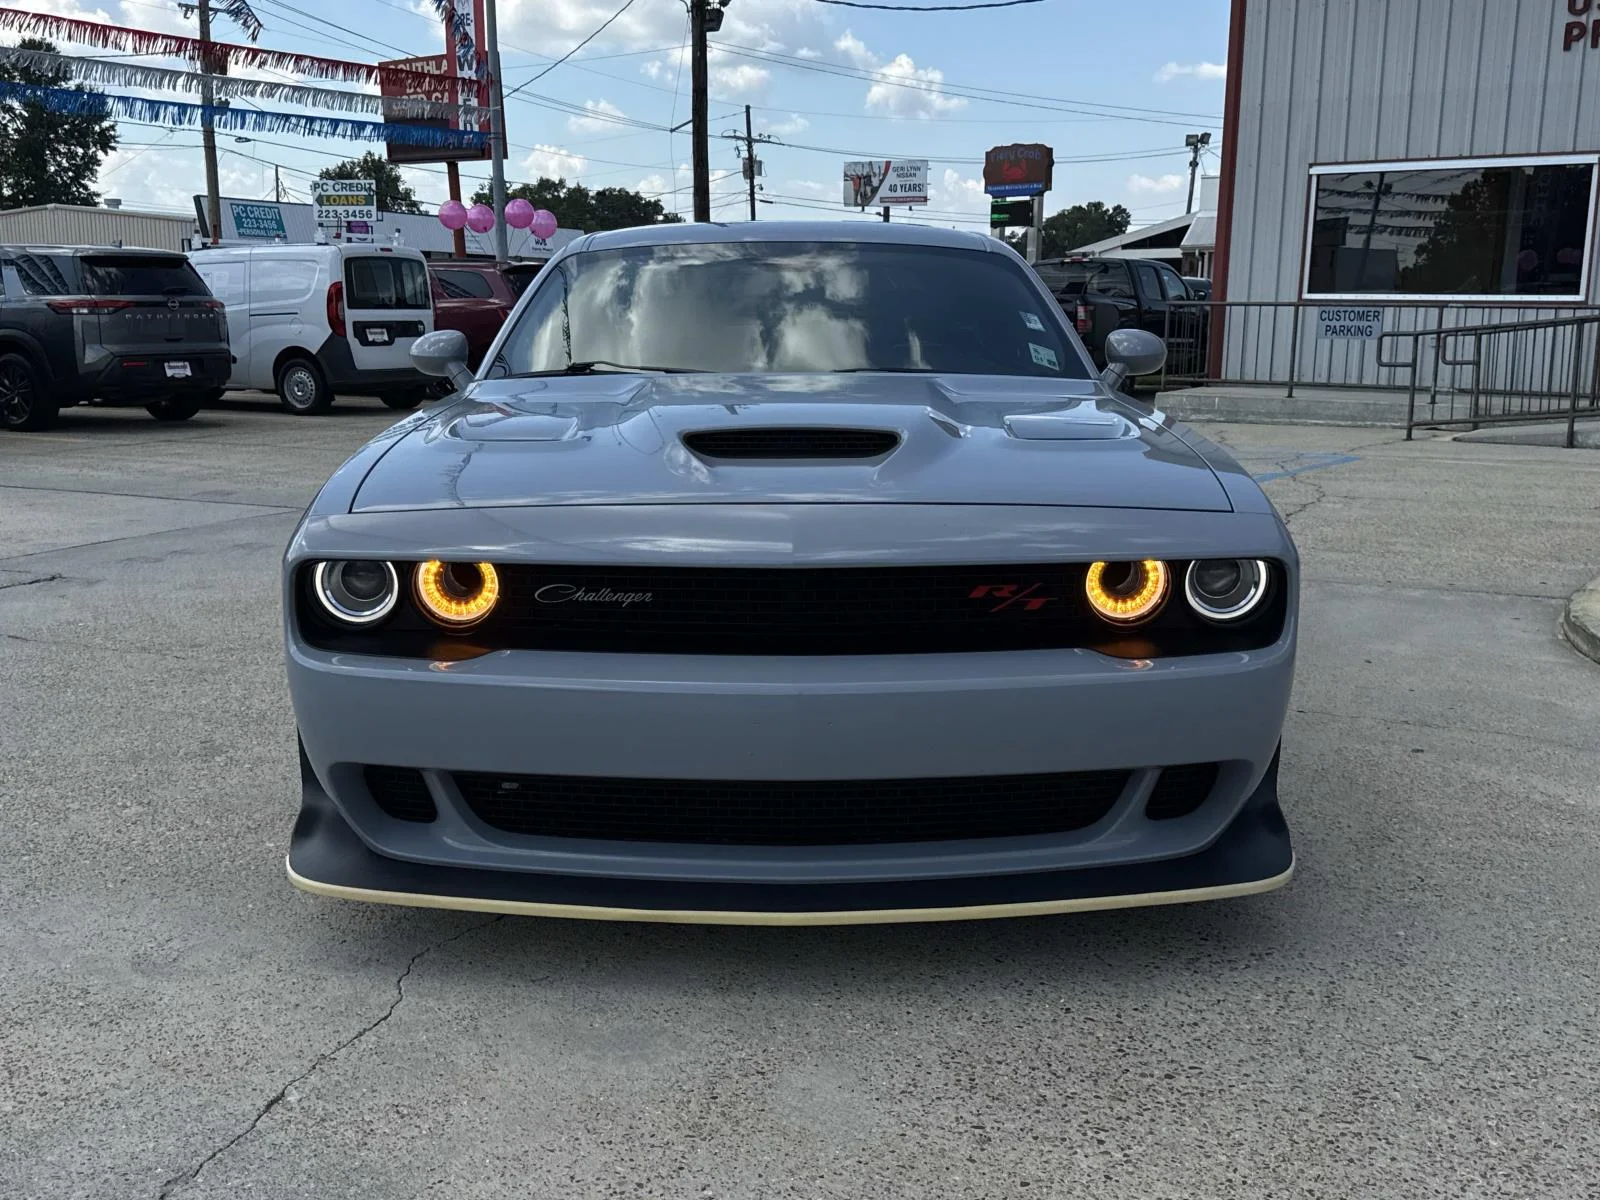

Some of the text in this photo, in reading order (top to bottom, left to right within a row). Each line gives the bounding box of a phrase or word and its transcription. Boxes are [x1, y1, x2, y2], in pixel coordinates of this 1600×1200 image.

[1568, 0, 1600, 16] U
[313, 182, 374, 193] PC CREDIT
[888, 183, 898, 193] 40
[323, 195, 366, 206] LOANS
[232, 204, 280, 220] PC CREDIT
[317, 209, 373, 219] 223-3456
[242, 218, 278, 230] 223-3456
[1320, 310, 1380, 322] CUSTOMER
[1325, 324, 1373, 337] PARKING
[534, 583, 653, 608] Challenger
[967, 582, 1058, 612] R/T
